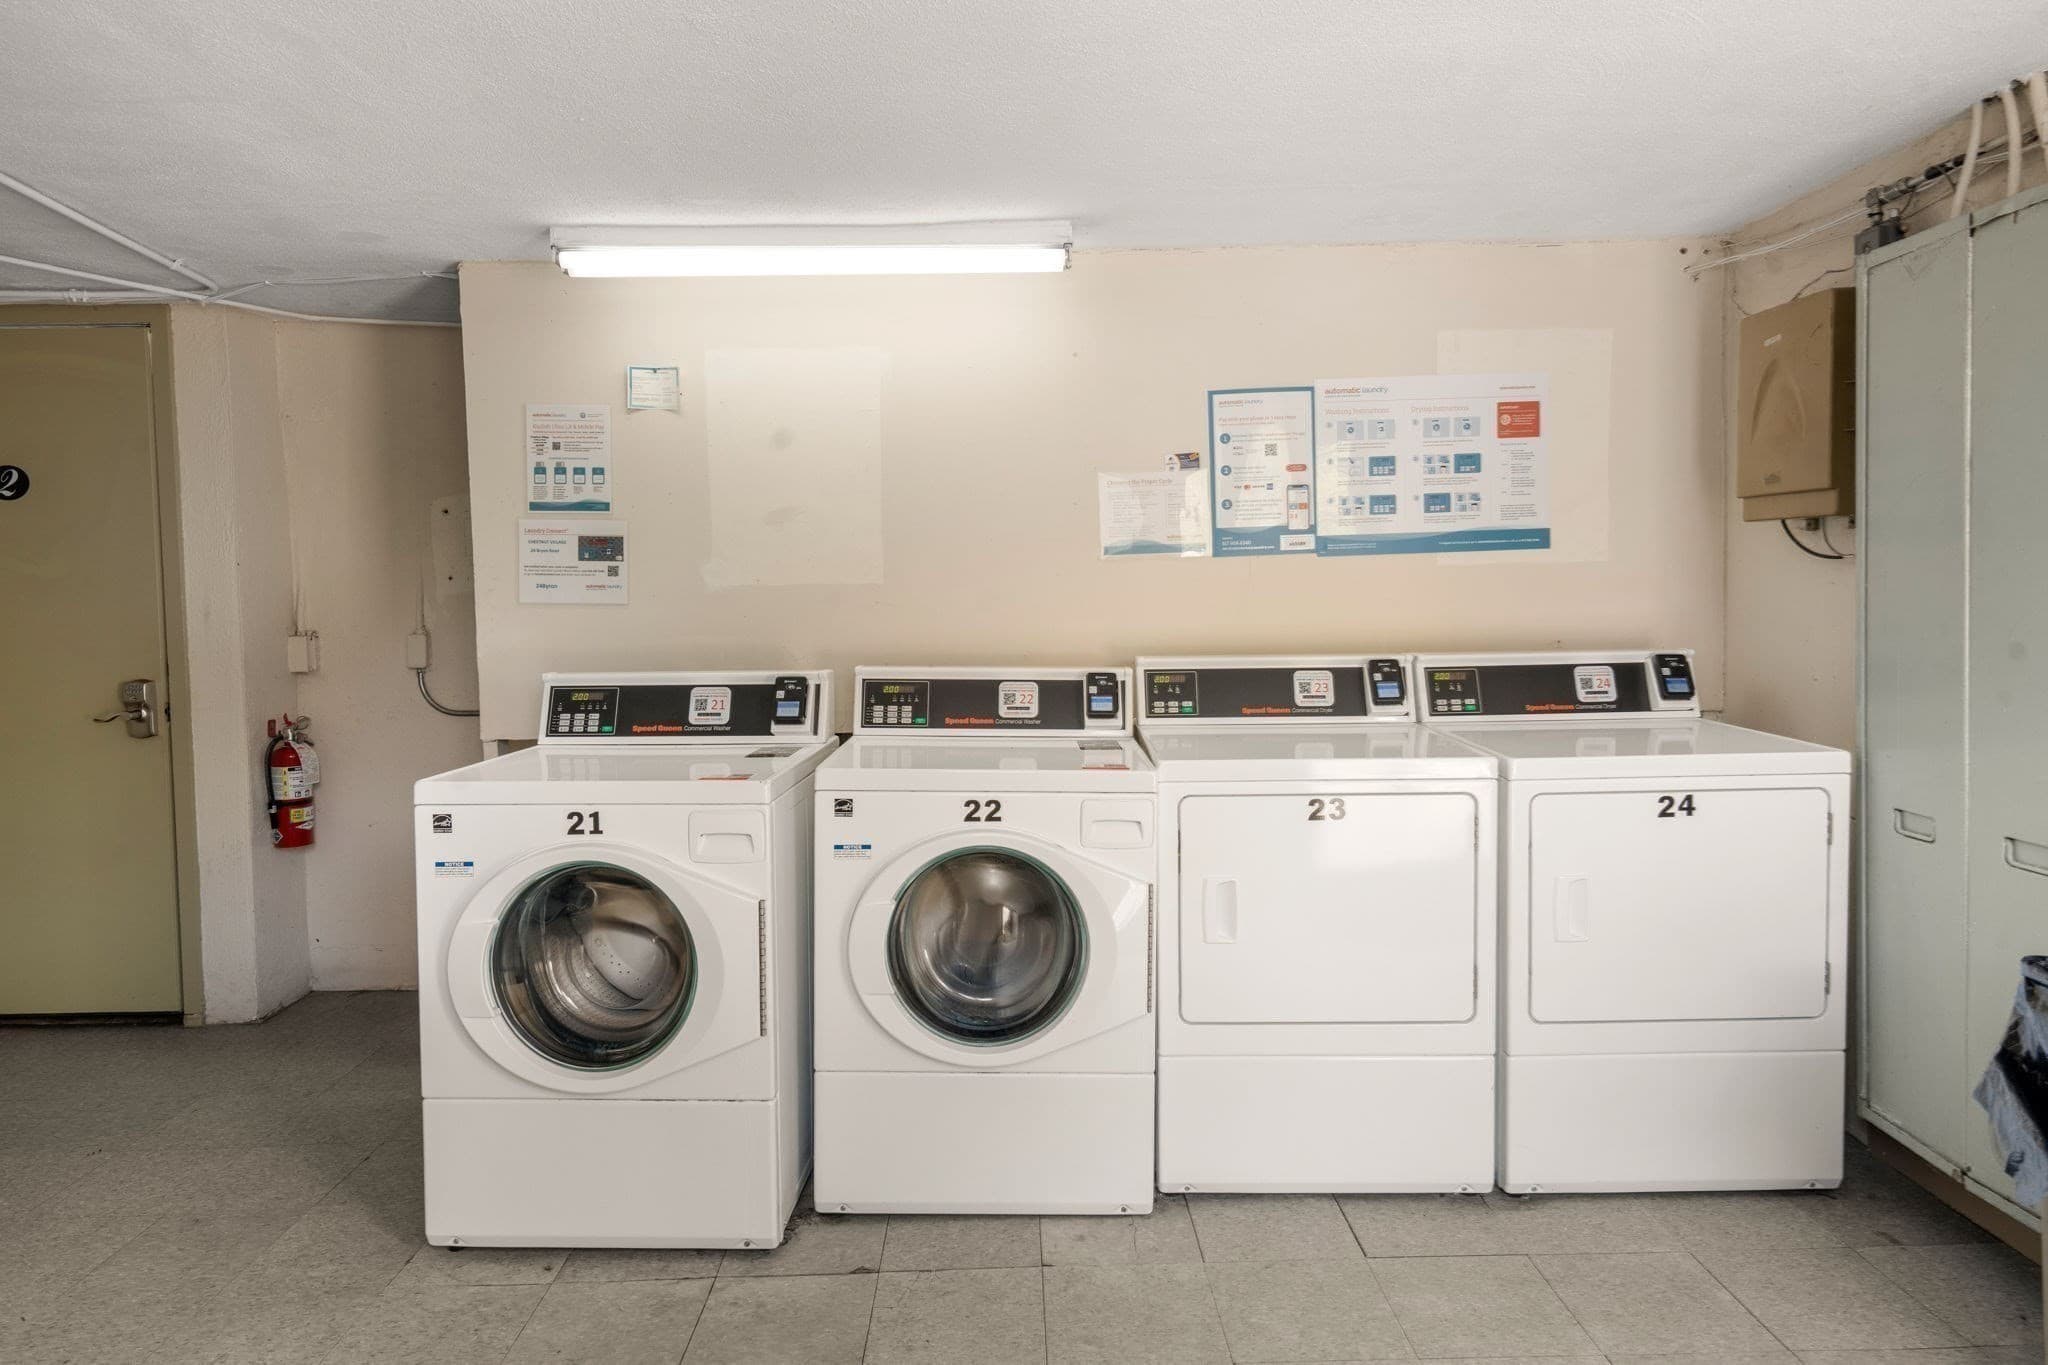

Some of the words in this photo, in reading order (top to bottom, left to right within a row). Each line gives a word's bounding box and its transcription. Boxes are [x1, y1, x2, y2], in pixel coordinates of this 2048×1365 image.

[1314, 682, 1329, 693] 23
[1596, 678, 1611, 689] 24
[711, 699, 726, 710] 21
[1019, 693, 1034, 704] 22
[963, 799, 1002, 822] 22
[1308, 798, 1346, 821] 23
[1657, 794, 1696, 817] 24
[566, 811, 603, 835] 21
